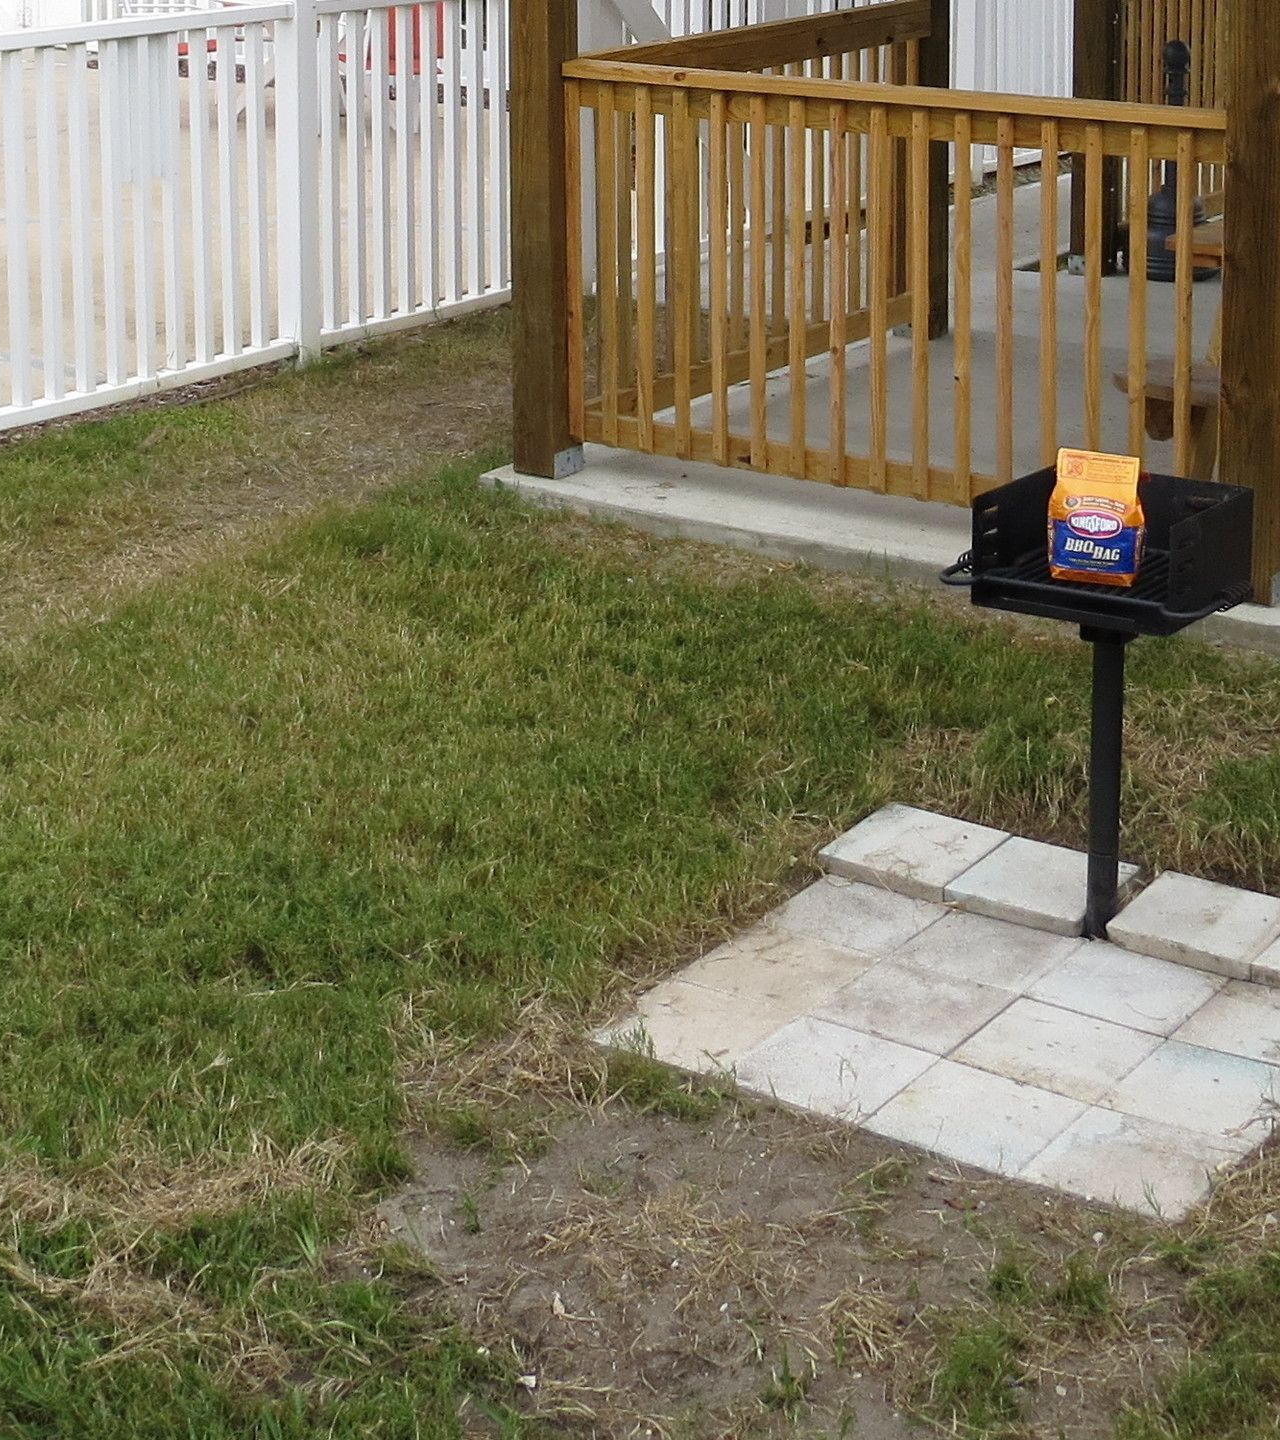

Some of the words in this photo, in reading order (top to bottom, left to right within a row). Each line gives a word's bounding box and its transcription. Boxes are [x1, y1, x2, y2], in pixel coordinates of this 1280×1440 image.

[1070, 514, 1118, 533] KINGSFORD
[1064, 537, 1094, 554] BBQ
[1092, 545, 1120, 560] BAG
